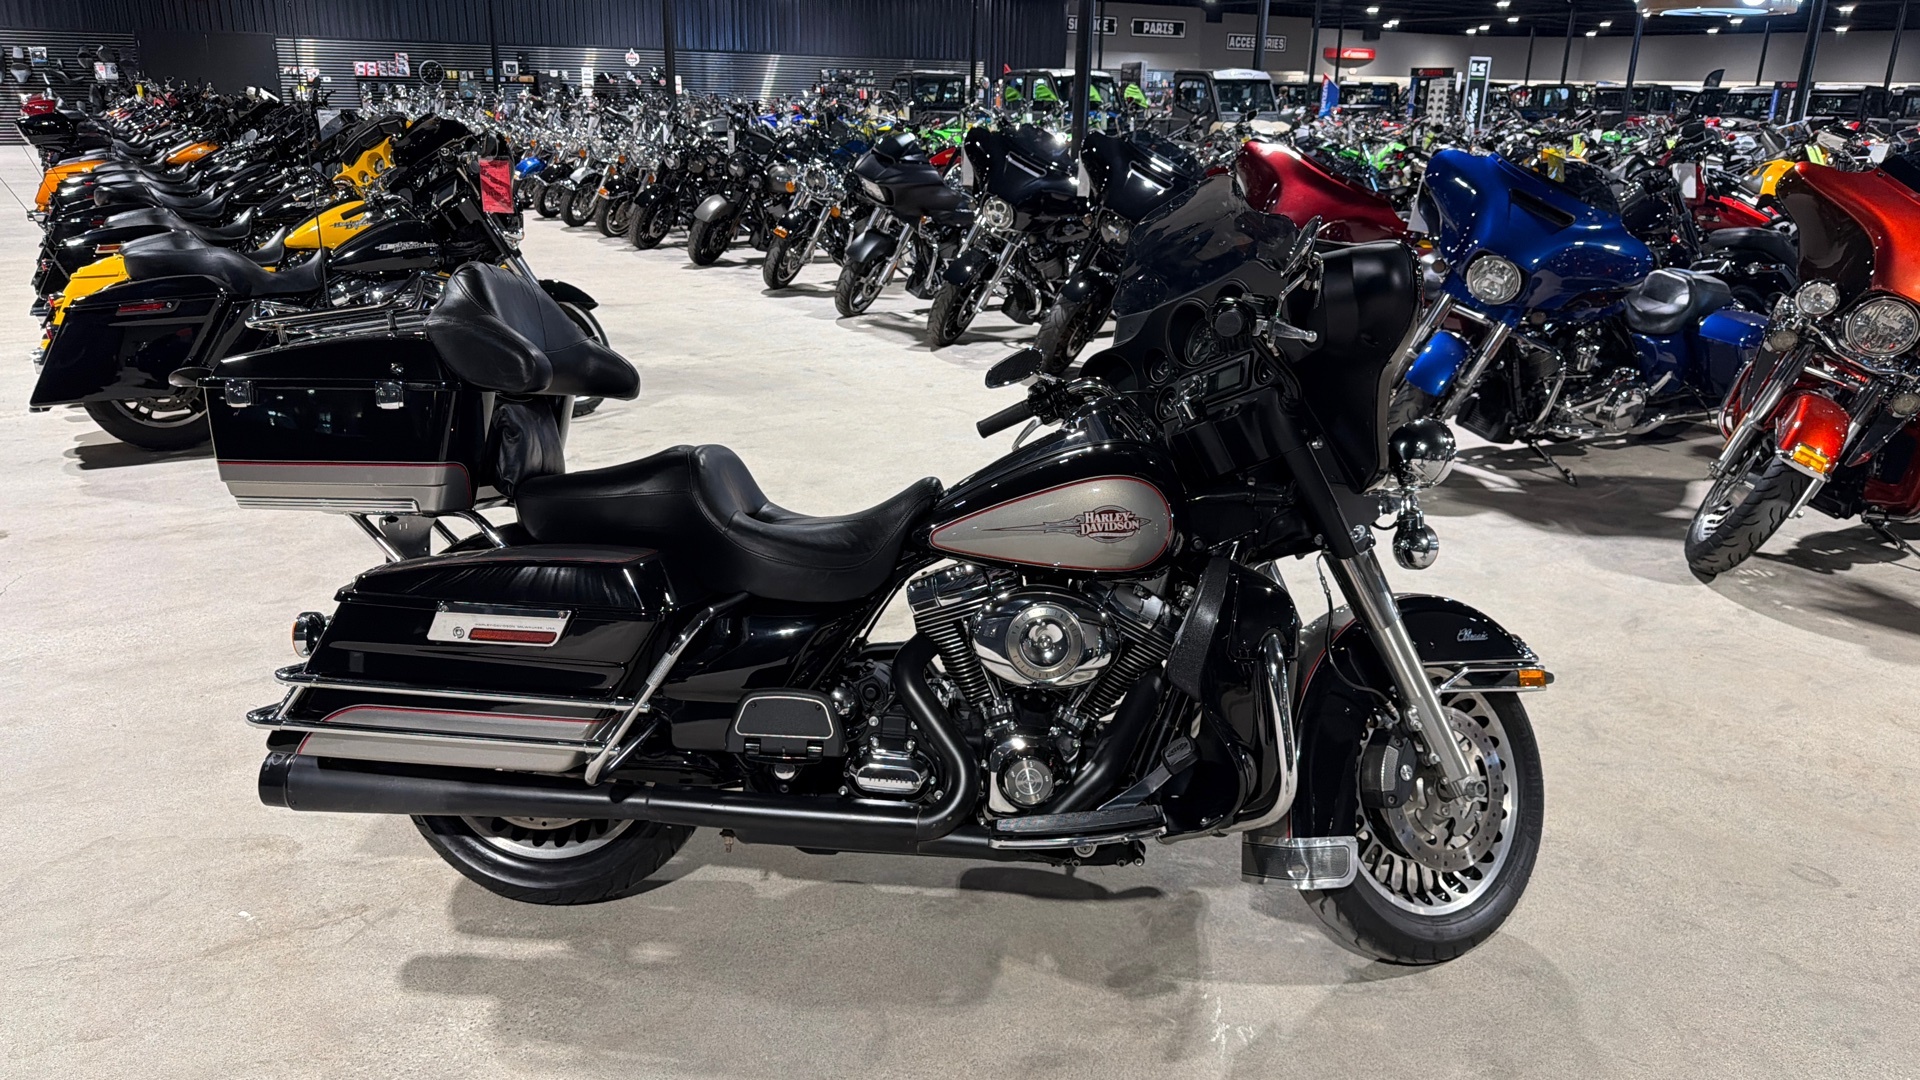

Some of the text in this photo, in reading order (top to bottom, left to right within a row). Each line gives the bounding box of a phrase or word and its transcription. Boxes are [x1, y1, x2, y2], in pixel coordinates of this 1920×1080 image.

[1068, 17, 1109, 32] SICE
[1143, 21, 1174, 35] PARTS
[1229, 36, 1284, 49] ACCESRIES
[1084, 511, 1135, 524] HARLEY-
[1080, 519, 1140, 535] DAVIDSON
